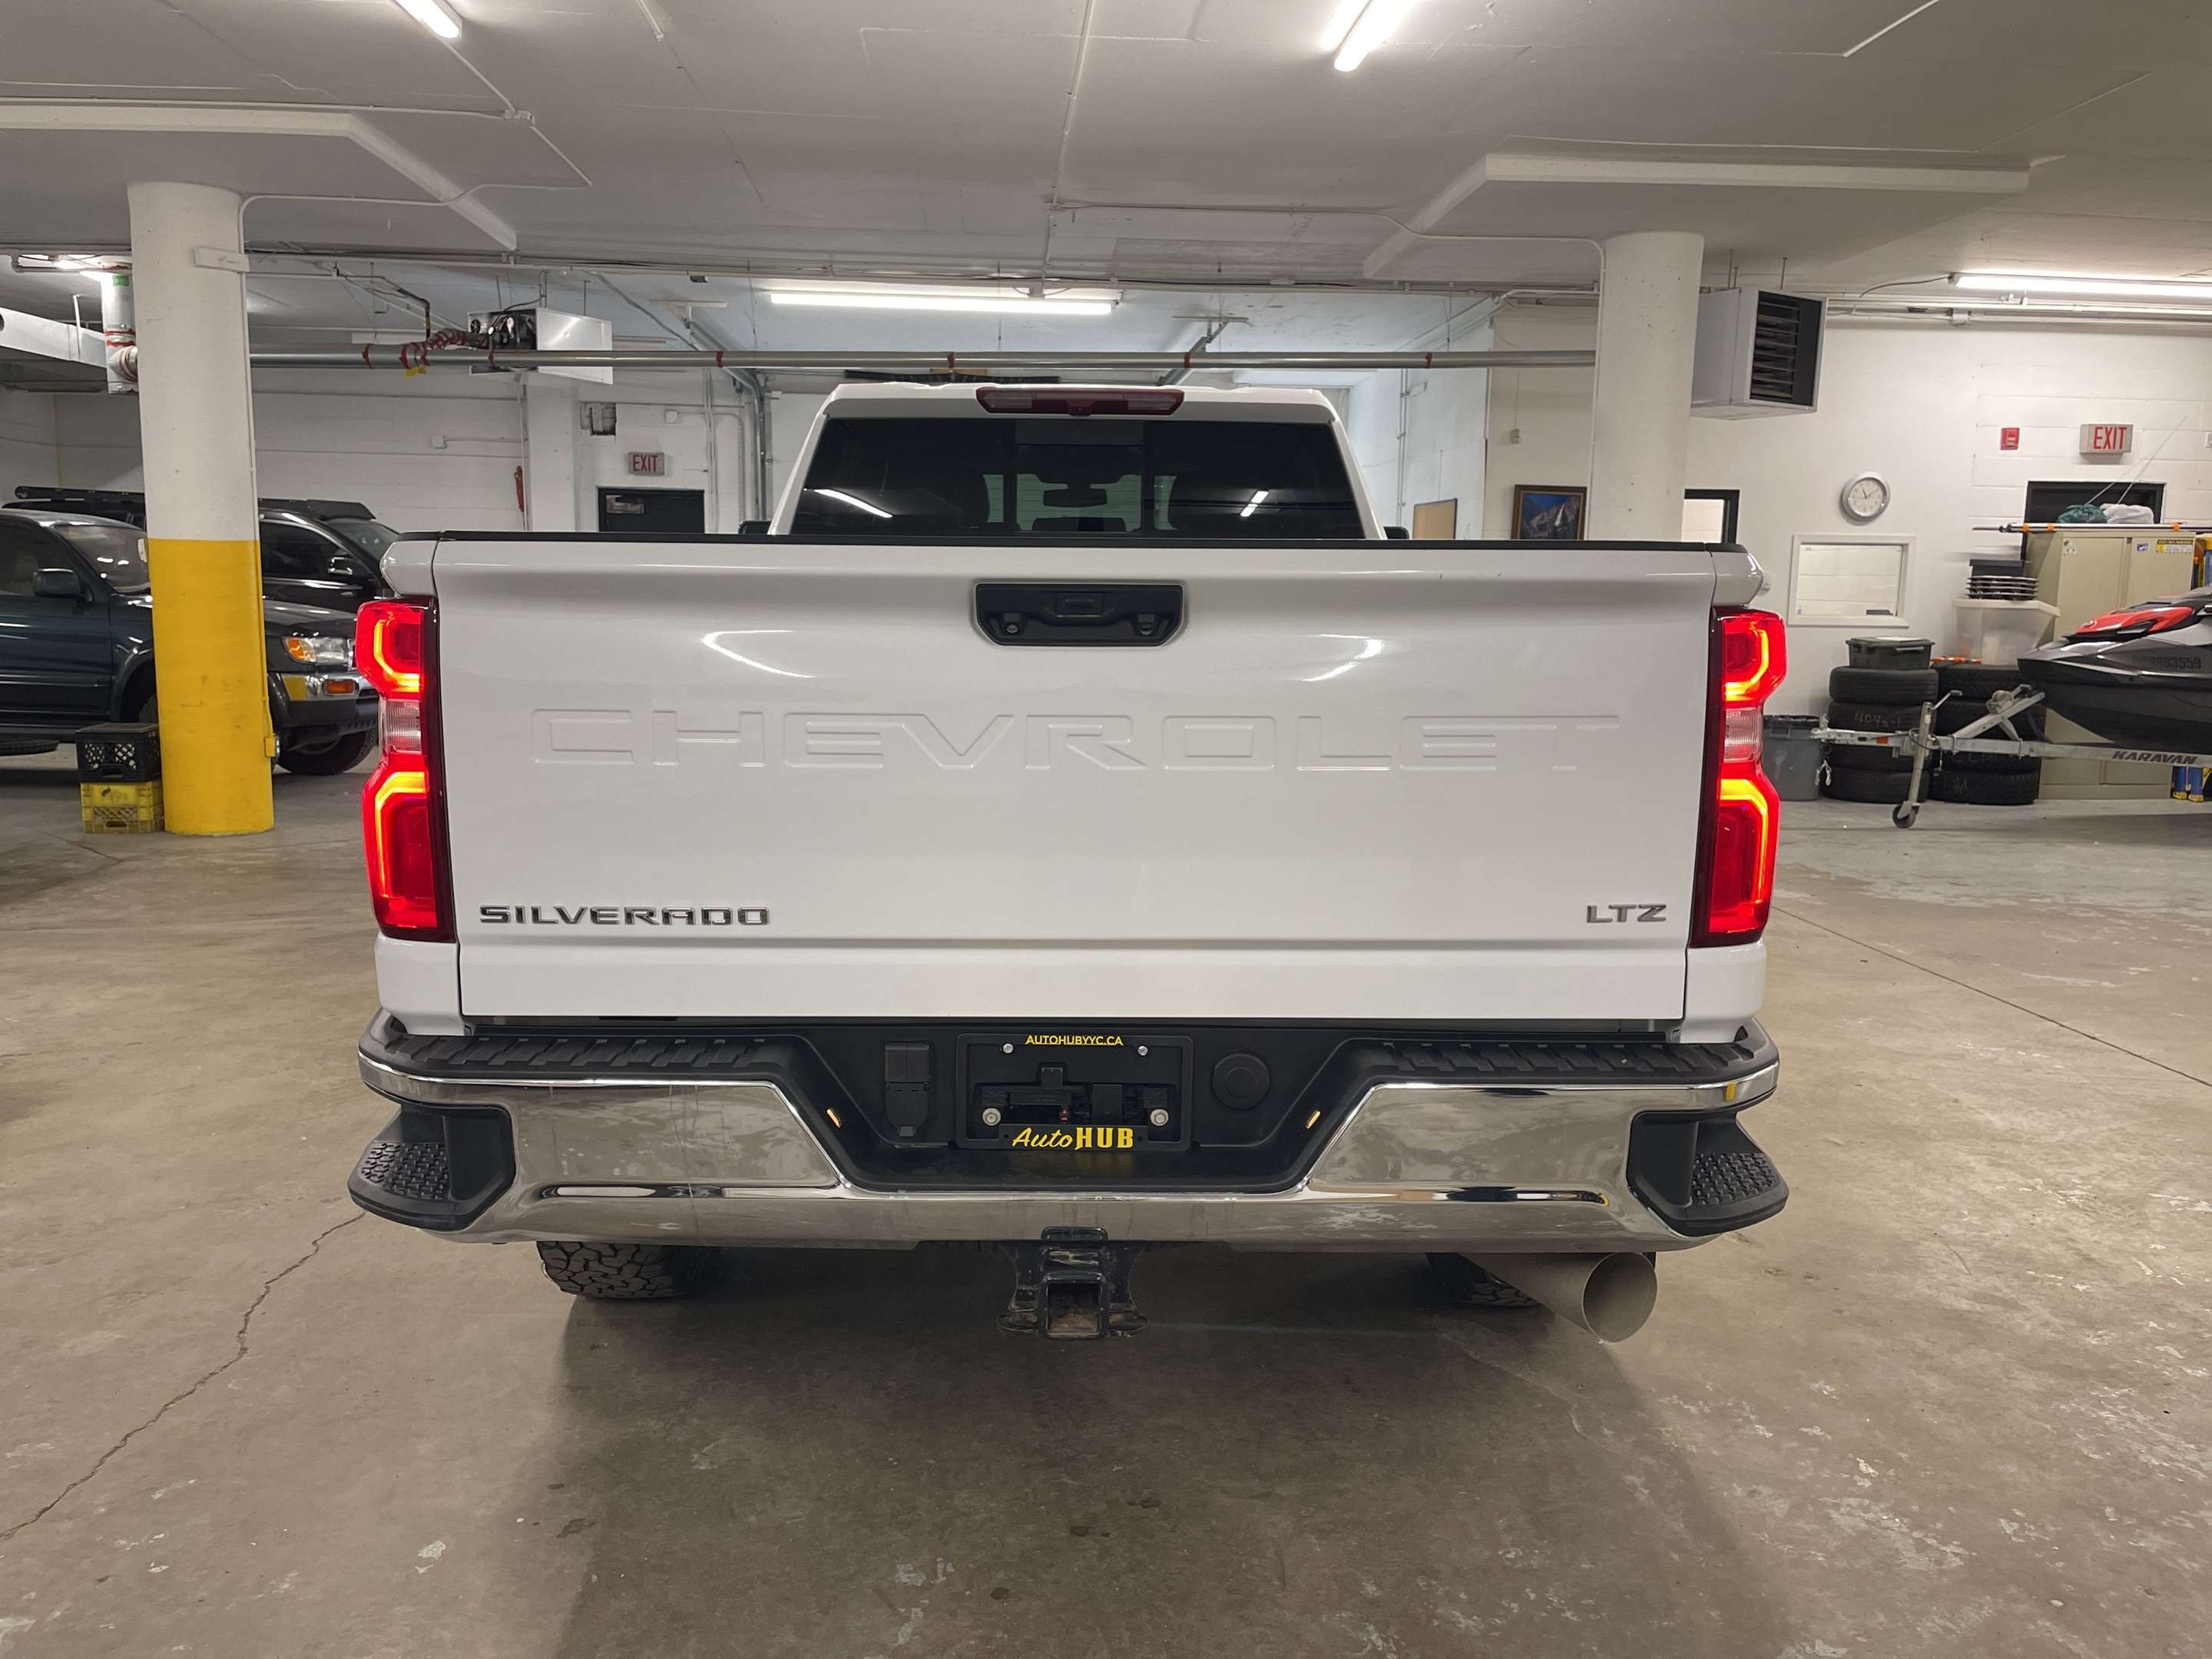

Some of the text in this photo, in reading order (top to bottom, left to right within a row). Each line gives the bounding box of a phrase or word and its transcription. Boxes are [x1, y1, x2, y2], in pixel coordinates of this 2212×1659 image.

[2093, 426, 2127, 450] EXIT
[632, 454, 659, 473] EXIT
[531, 709, 1621, 771] CHEVROLET
[2111, 750, 2198, 765] KARAVAN
[479, 904, 770, 926] SILVERADO
[1586, 903, 1667, 923] LTZ
[1025, 1035, 1124, 1046] AUTOHUBYYC.CA
